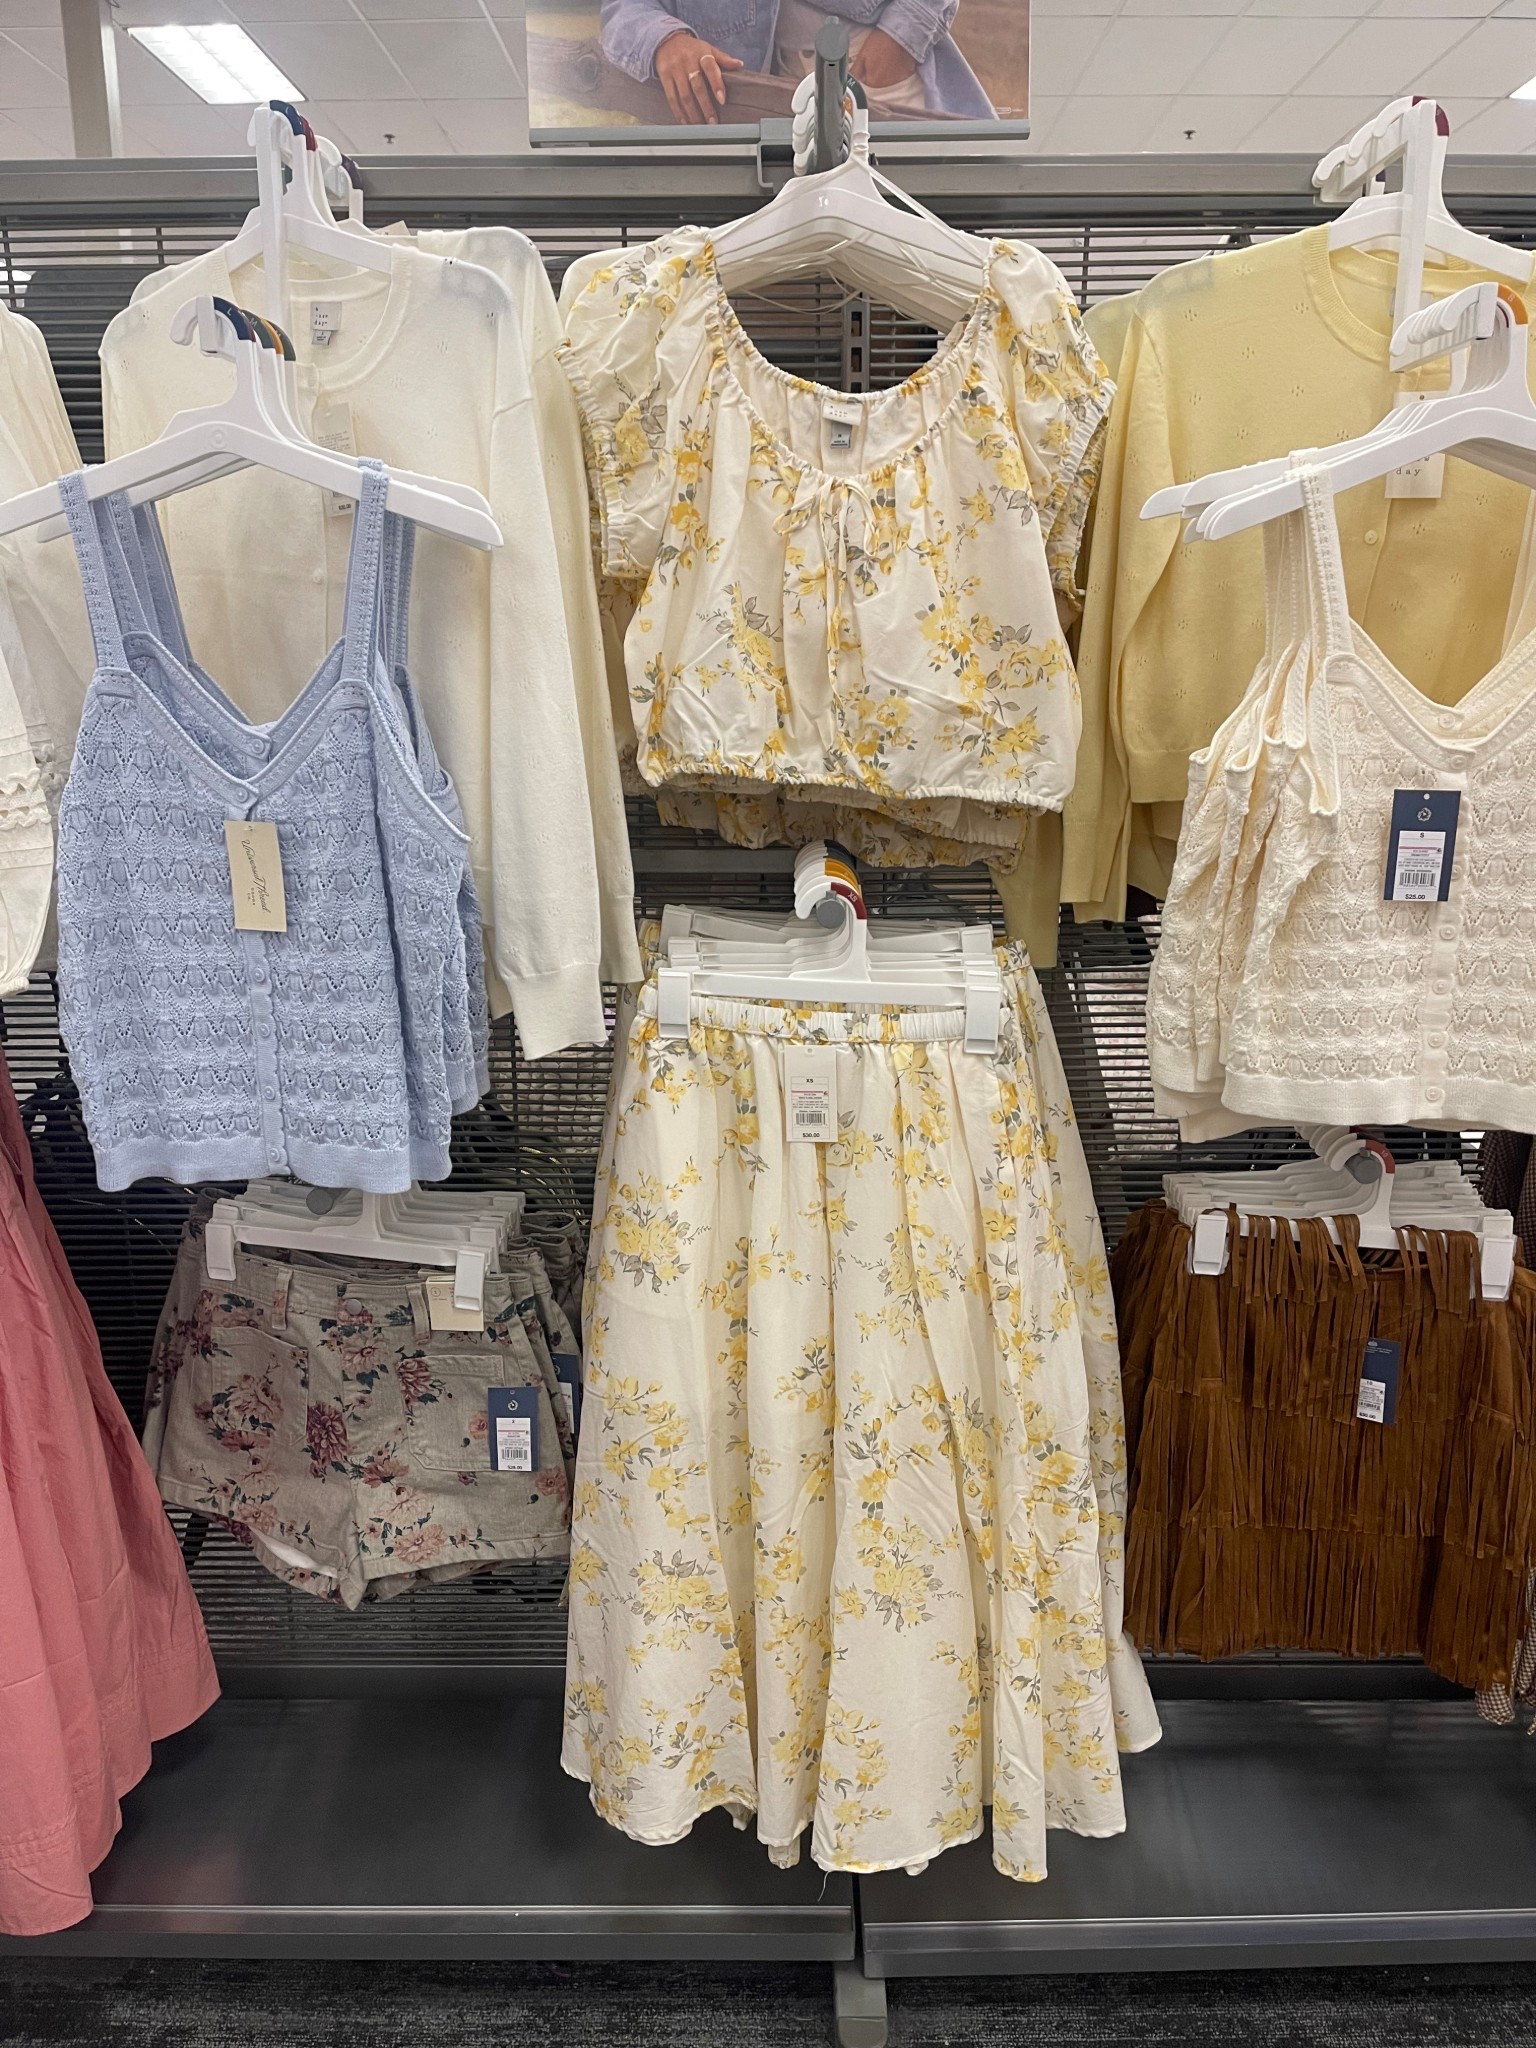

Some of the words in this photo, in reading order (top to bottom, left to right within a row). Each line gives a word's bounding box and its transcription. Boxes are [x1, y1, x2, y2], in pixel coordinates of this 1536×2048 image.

[846, 77, 856, 87] M
[1396, 467, 1420, 477] day
[241, 839, 264, 882] Universal
[253, 876, 271, 914] Thread
[847, 892, 858, 903] XS
